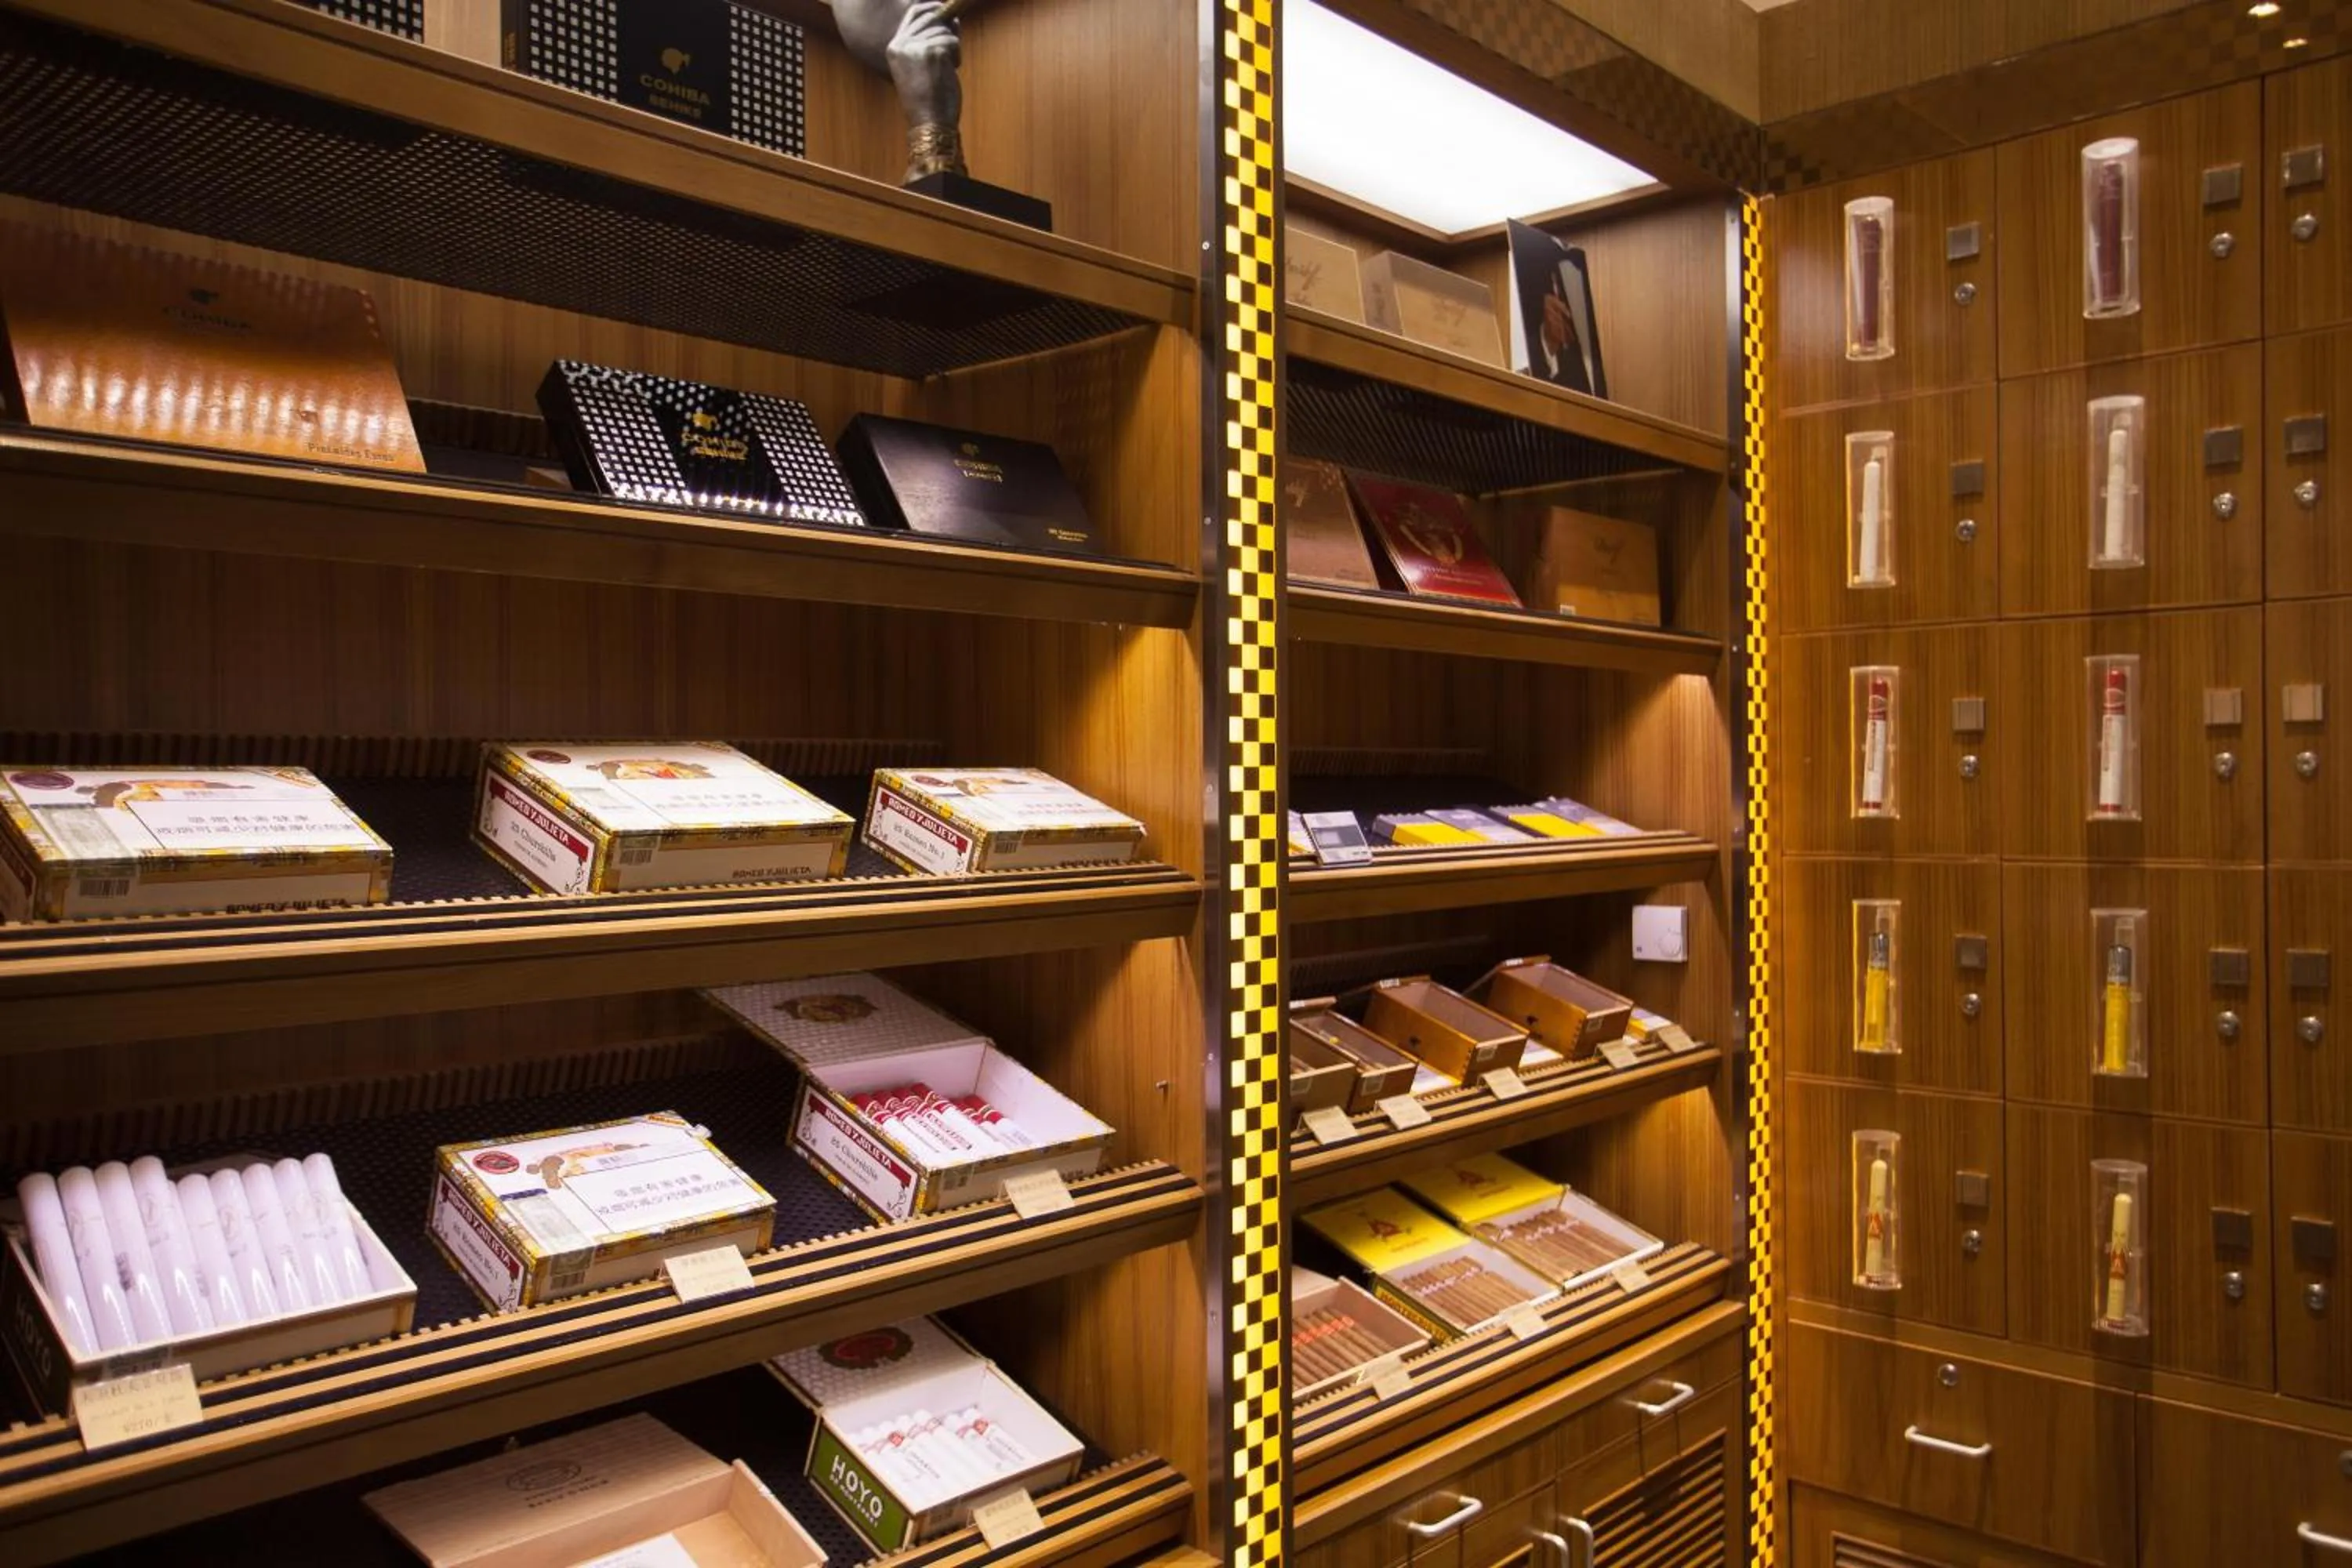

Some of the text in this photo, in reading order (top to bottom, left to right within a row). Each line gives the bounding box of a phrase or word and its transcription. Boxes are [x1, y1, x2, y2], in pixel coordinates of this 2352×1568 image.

[640, 74, 710, 105] COHIBA
[534, 814, 570, 847] JULIETA
[921, 816, 958, 846] JULIETA
[772, 866, 812, 877] JULIETA
[824, 1108, 851, 1136] ROMEO
[856, 1135, 892, 1171] JULIETA
[16, 1294, 52, 1377] HOYO
[832, 1454, 884, 1519] HOYO
